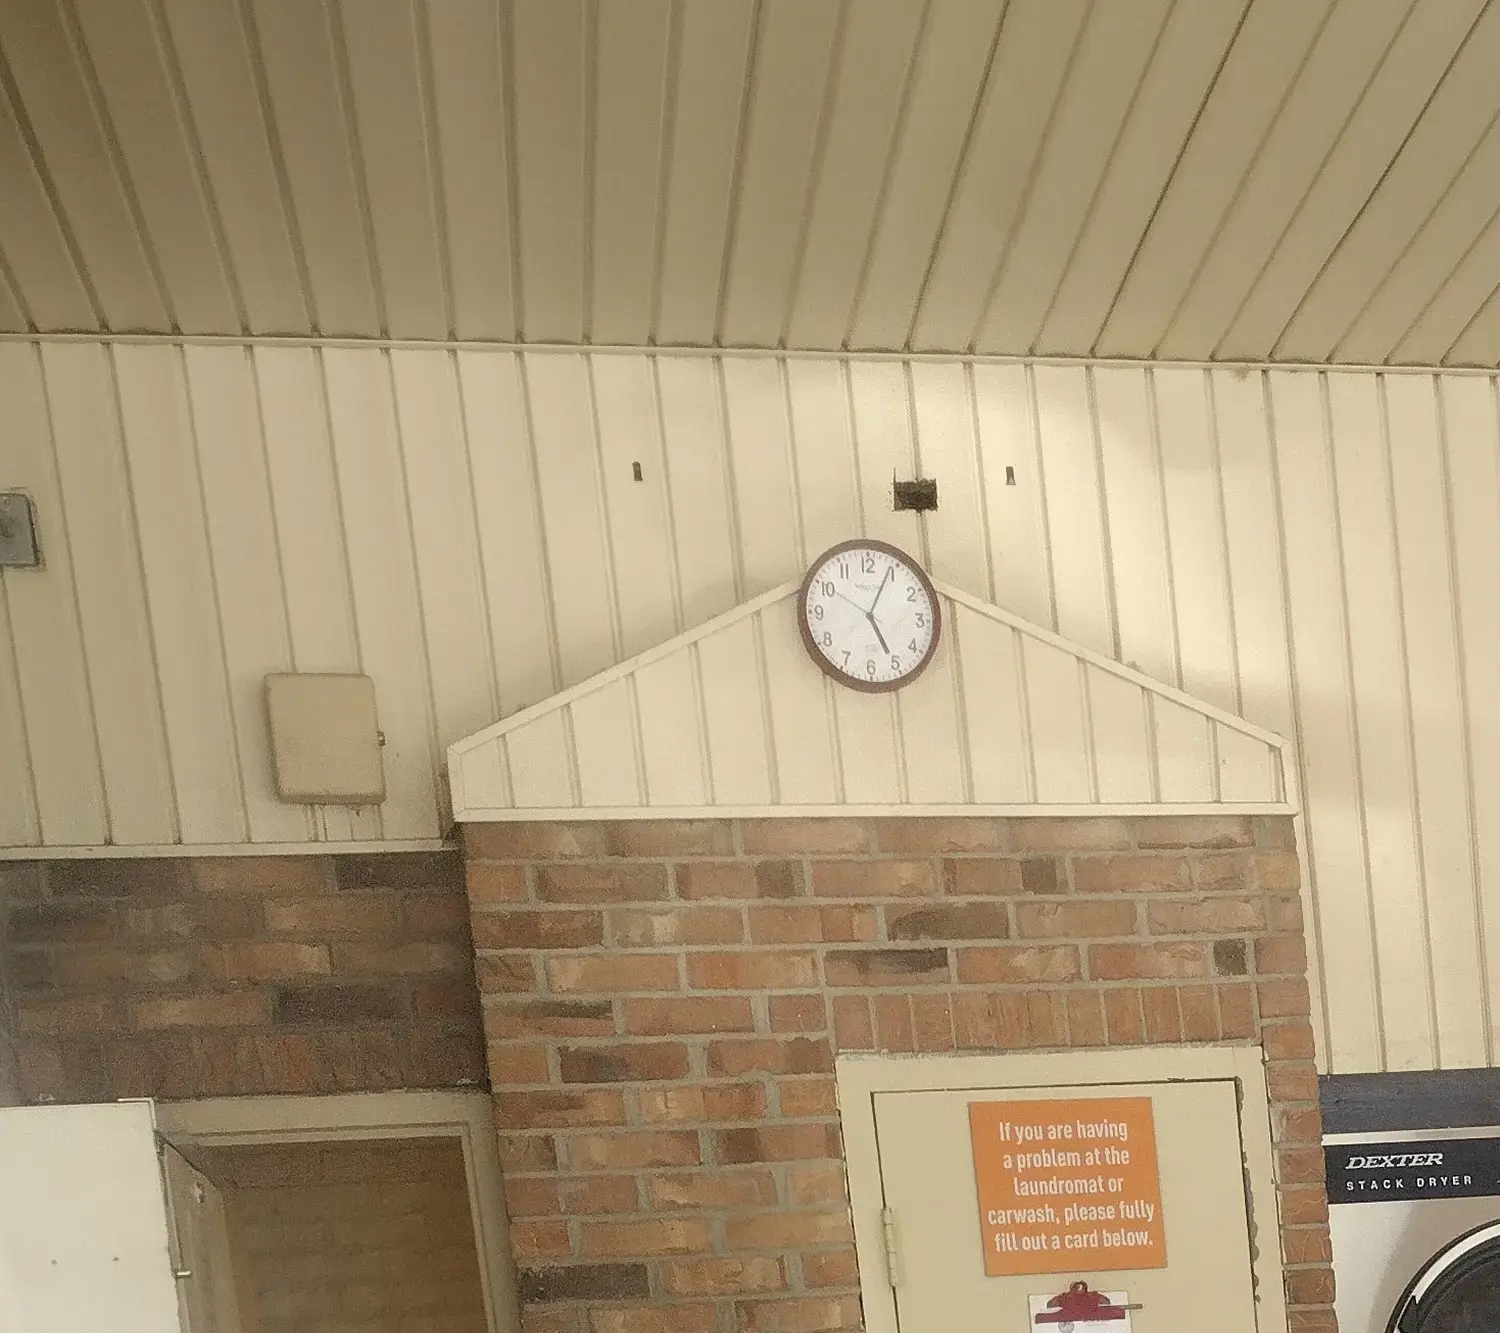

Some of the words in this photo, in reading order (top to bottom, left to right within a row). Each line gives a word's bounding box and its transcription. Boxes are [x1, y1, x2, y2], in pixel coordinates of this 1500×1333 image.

[840, 563, 849, 580] 11
[861, 556, 876, 574] 12
[821, 581, 835, 598] 10
[906, 586, 917, 602] 2
[814, 605, 824, 621] 9
[915, 612, 925, 628] 3
[823, 632, 833, 647] 8
[908, 638, 917, 653] 4
[842, 651, 851, 666] 7
[891, 655, 900, 670] 5
[866, 660, 876, 675] 6
[1000, 1121, 1010, 1142] If
[1015, 1125, 1043, 1145] you
[1047, 1125, 1072, 1140] are
[1077, 1119, 1128, 1141] having
[1003, 1155, 1012, 1169] a
[1017, 1149, 1081, 1172] problem
[1085, 1150, 1101, 1166] at
[1104, 1146, 1130, 1165] the
[1345, 1153, 1443, 1170] DEXTER
[1014, 1175, 1104, 1196] laundromat
[1108, 1177, 1124, 1193] or
[1346, 1178, 1404, 1191] STACK
[1416, 1175, 1473, 1188] DRYER
[988, 1204, 1060, 1225] carwash,
[1064, 1202, 1115, 1225] please
[1119, 1199, 1155, 1222] fully
[994, 1232, 1018, 1252] fill
[1022, 1233, 1047, 1250] out
[1051, 1235, 1060, 1250] a
[1064, 1229, 1098, 1249] card
[1102, 1228, 1153, 1247] below.
